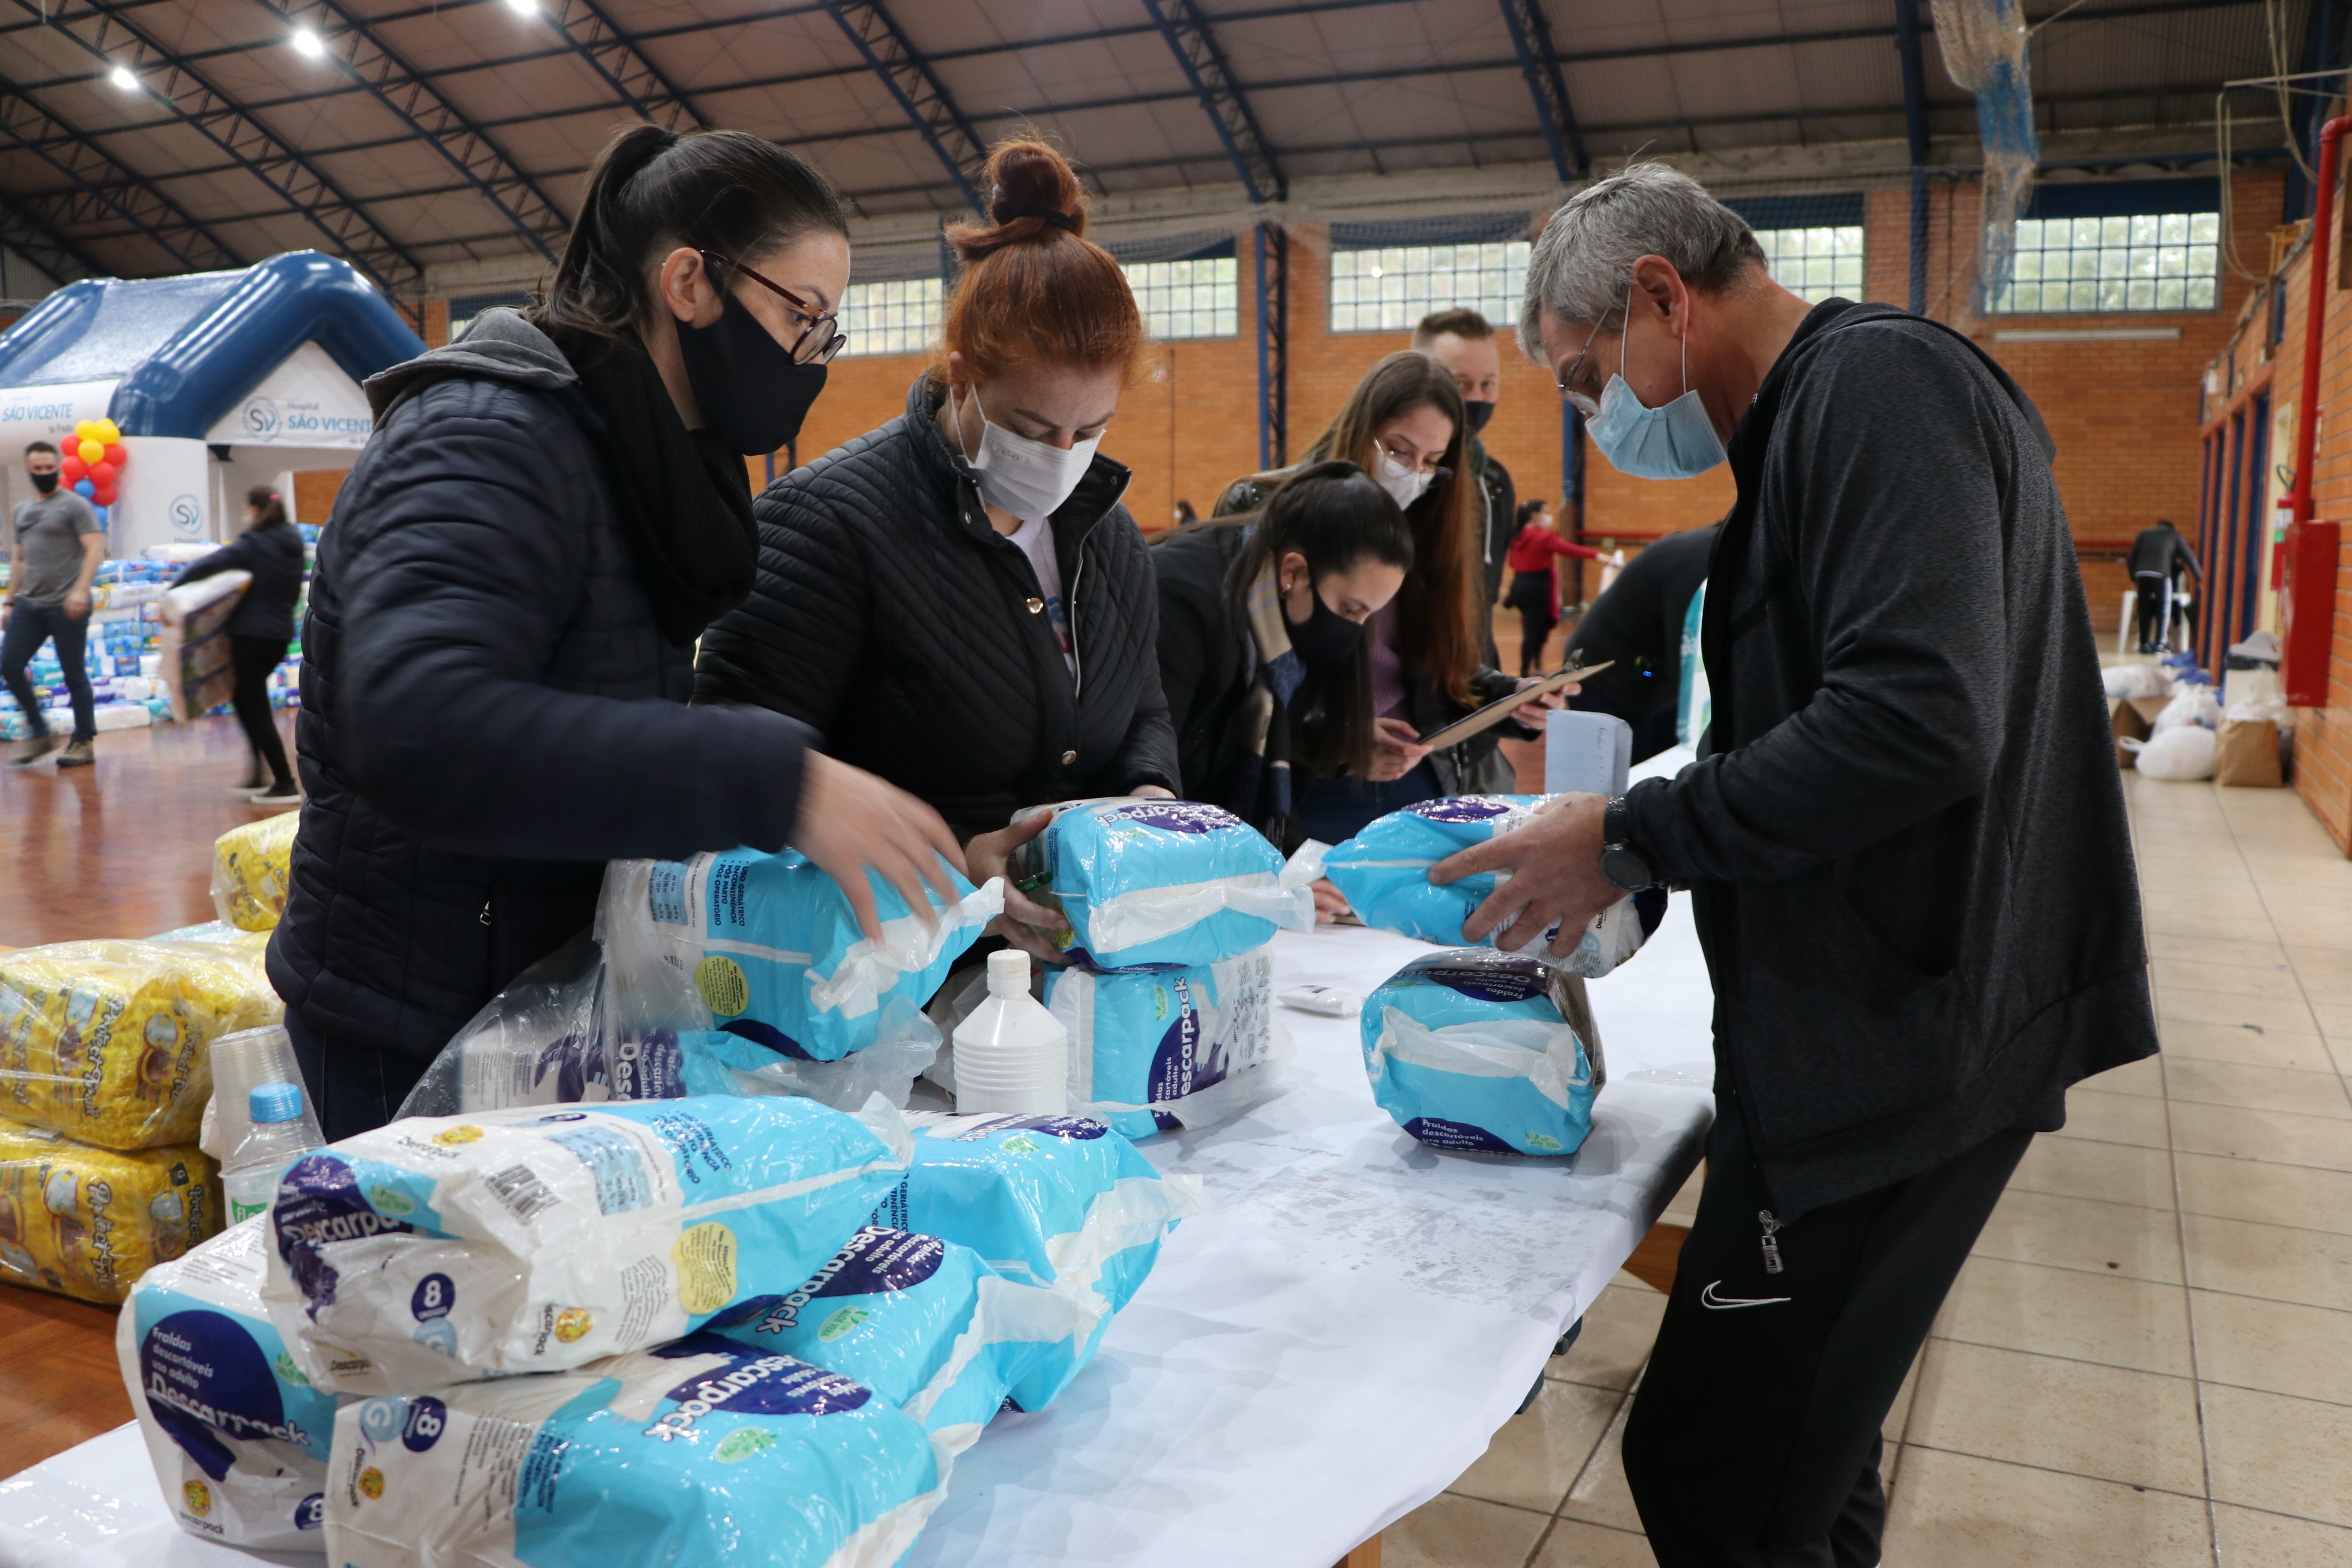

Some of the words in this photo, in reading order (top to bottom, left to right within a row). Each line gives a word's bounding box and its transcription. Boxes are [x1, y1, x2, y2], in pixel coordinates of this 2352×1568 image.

[3, 404, 25, 421] SÃO
[28, 403, 73, 419] VICENTE
[289, 413, 318, 430] SÃO
[321, 416, 373, 433] VICENT
[716, 864, 725, 878] PÓS
[724, 865, 733, 879] PÓS
[740, 866, 749, 882] USO
[714, 880, 722, 926] OPERATÓRIO
[730, 865, 741, 924] INCONTINÊNCIA
[737, 883, 746, 927] GERIÁTRICO
[1392, 969, 1531, 983] Descarpack
[1463, 980, 1526, 992] descartáveis
[1486, 987, 1524, 1000] Fraldas
[1174, 976, 1195, 1096] escarpack
[654, 1044, 667, 1098] descartáv
[1154, 1081, 1163, 1118] Fldas
[1422, 1118, 1458, 1133] Fraldas
[1422, 1128, 1484, 1141] descartáveis
[891, 1187, 900, 1230] TINÊNCIA
[900, 1181, 909, 1232] GERIÁTRICO
[865, 1238, 896, 1262] adulto
[755, 1225, 898, 1334] Descarpack
[423, 1279, 442, 1308] 8
[152, 1326, 192, 1352] Fraldas
[152, 1342, 214, 1378] descartáveis
[169, 1367, 200, 1389] adulto
[642, 1354, 813, 1443] escarpack
[366, 1401, 392, 1428] G
[416, 1413, 442, 1438] 8
